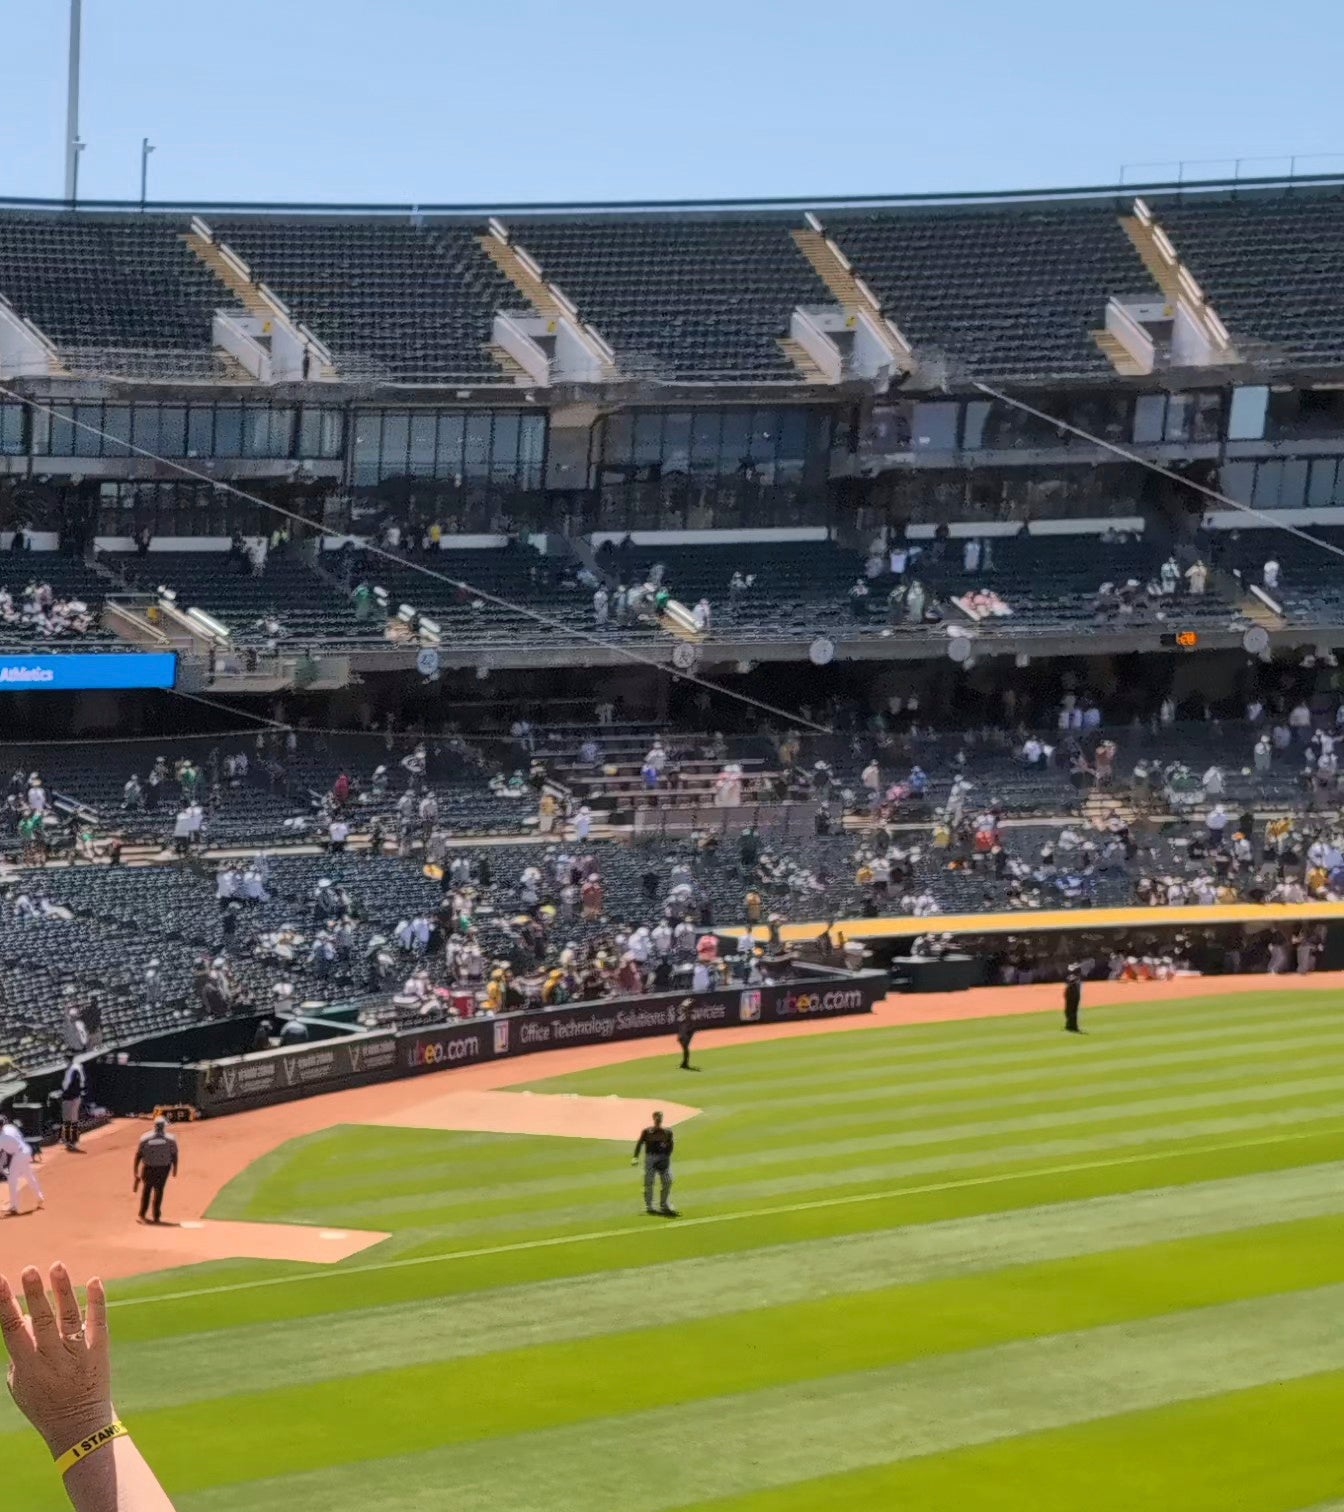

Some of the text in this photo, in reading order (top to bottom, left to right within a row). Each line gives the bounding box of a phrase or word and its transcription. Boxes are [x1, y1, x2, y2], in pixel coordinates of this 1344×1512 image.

[520, 1020, 550, 1043] Office
[553, 1014, 614, 1041] Technology
[616, 1007, 664, 1030] Solutions
[72, 1424, 121, 1458] I STAND
